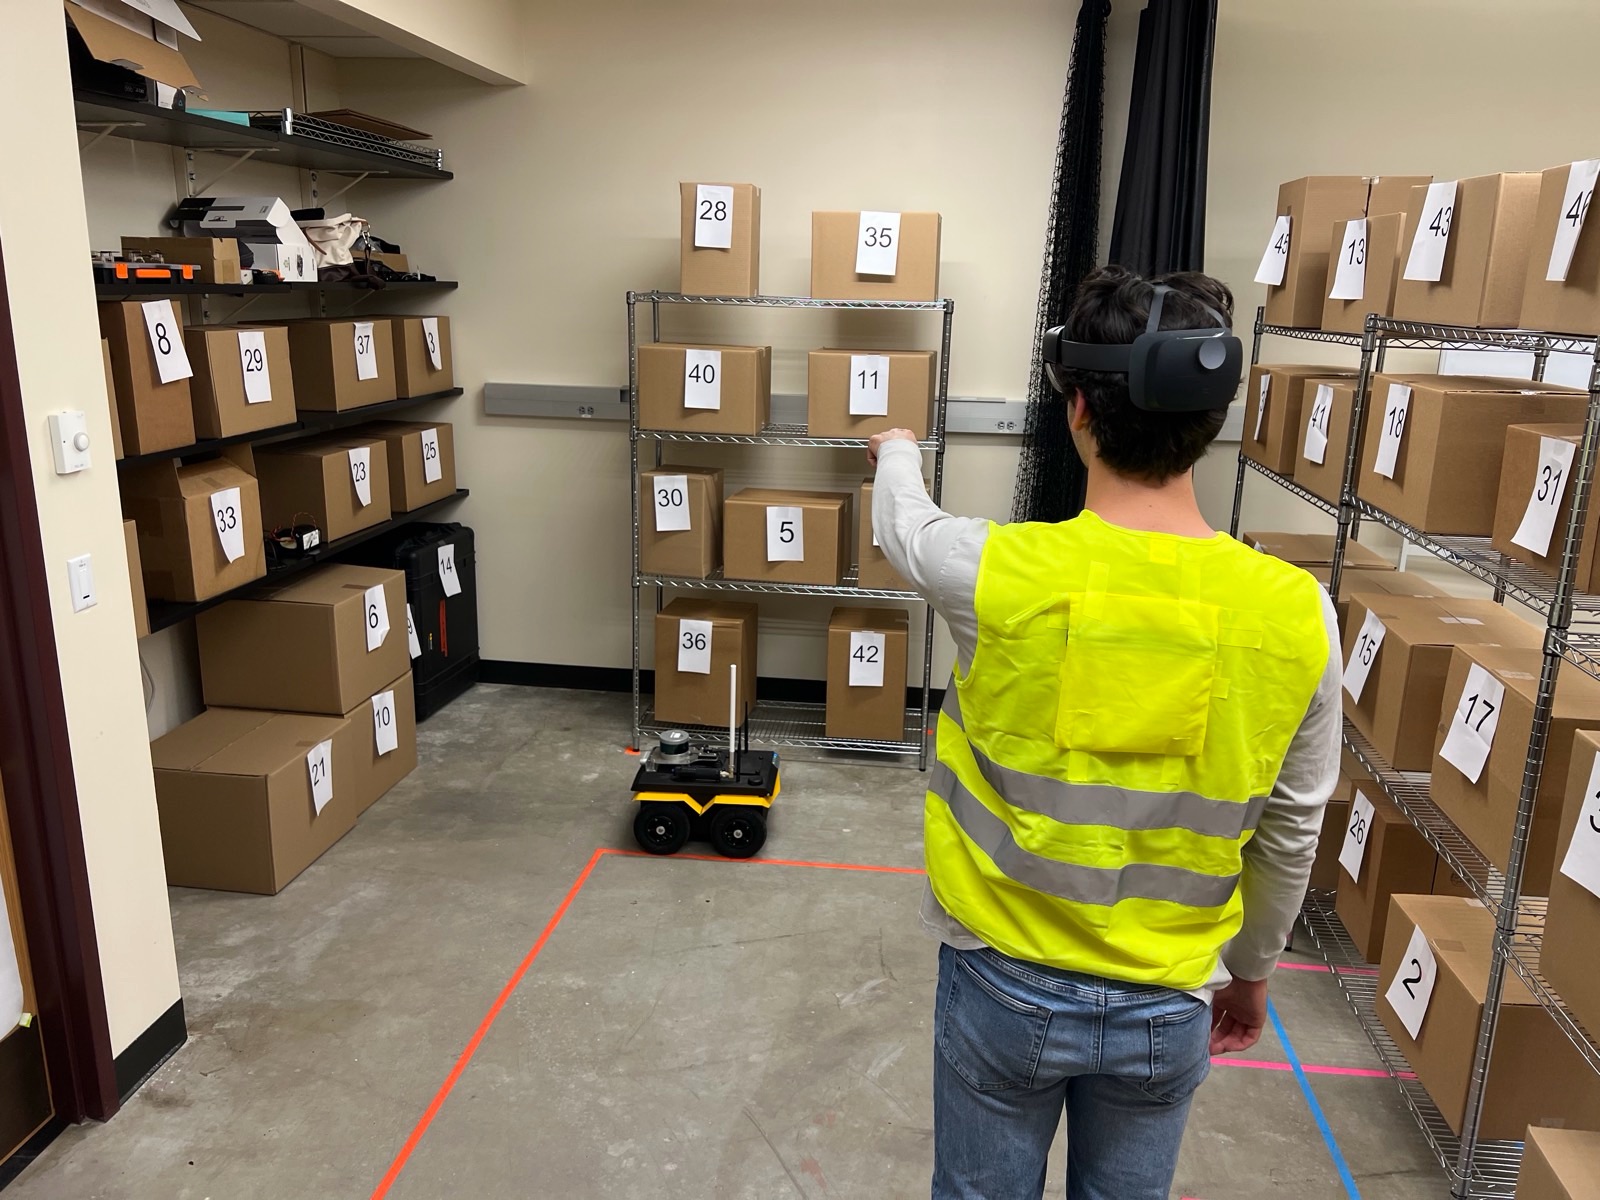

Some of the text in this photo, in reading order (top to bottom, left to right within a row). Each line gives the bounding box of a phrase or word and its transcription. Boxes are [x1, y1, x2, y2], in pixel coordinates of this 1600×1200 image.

[700, 200, 727, 221] 28
[1429, 207, 1452, 237] 43
[864, 227, 892, 248] 35
[1274, 233, 1289, 254] 45
[1348, 238, 1365, 265] 13
[156, 323, 171, 355] 8
[357, 335, 370, 355] 37
[428, 332, 436, 353] 3
[244, 348, 263, 372] 29
[688, 364, 715, 383] 40
[858, 370, 878, 389] 11
[1311, 404, 1327, 429] 41
[1389, 407, 1405, 438] 18
[423, 441, 437, 461] 25
[353, 462, 366, 482] 23
[1537, 465, 1563, 506] 31
[657, 489, 683, 507] 30
[217, 506, 236, 533] 33
[779, 521, 795, 543] 5
[440, 556, 453, 574] 14
[368, 604, 379, 629] 6
[682, 632, 707, 651] 36
[1357, 633, 1376, 667] 15
[852, 645, 879, 663] 42
[375, 706, 391, 729] 10
[1464, 693, 1495, 732] 17
[311, 757, 326, 786] 21
[1349, 810, 1366, 845] 26
[1402, 958, 1422, 1000] 2
